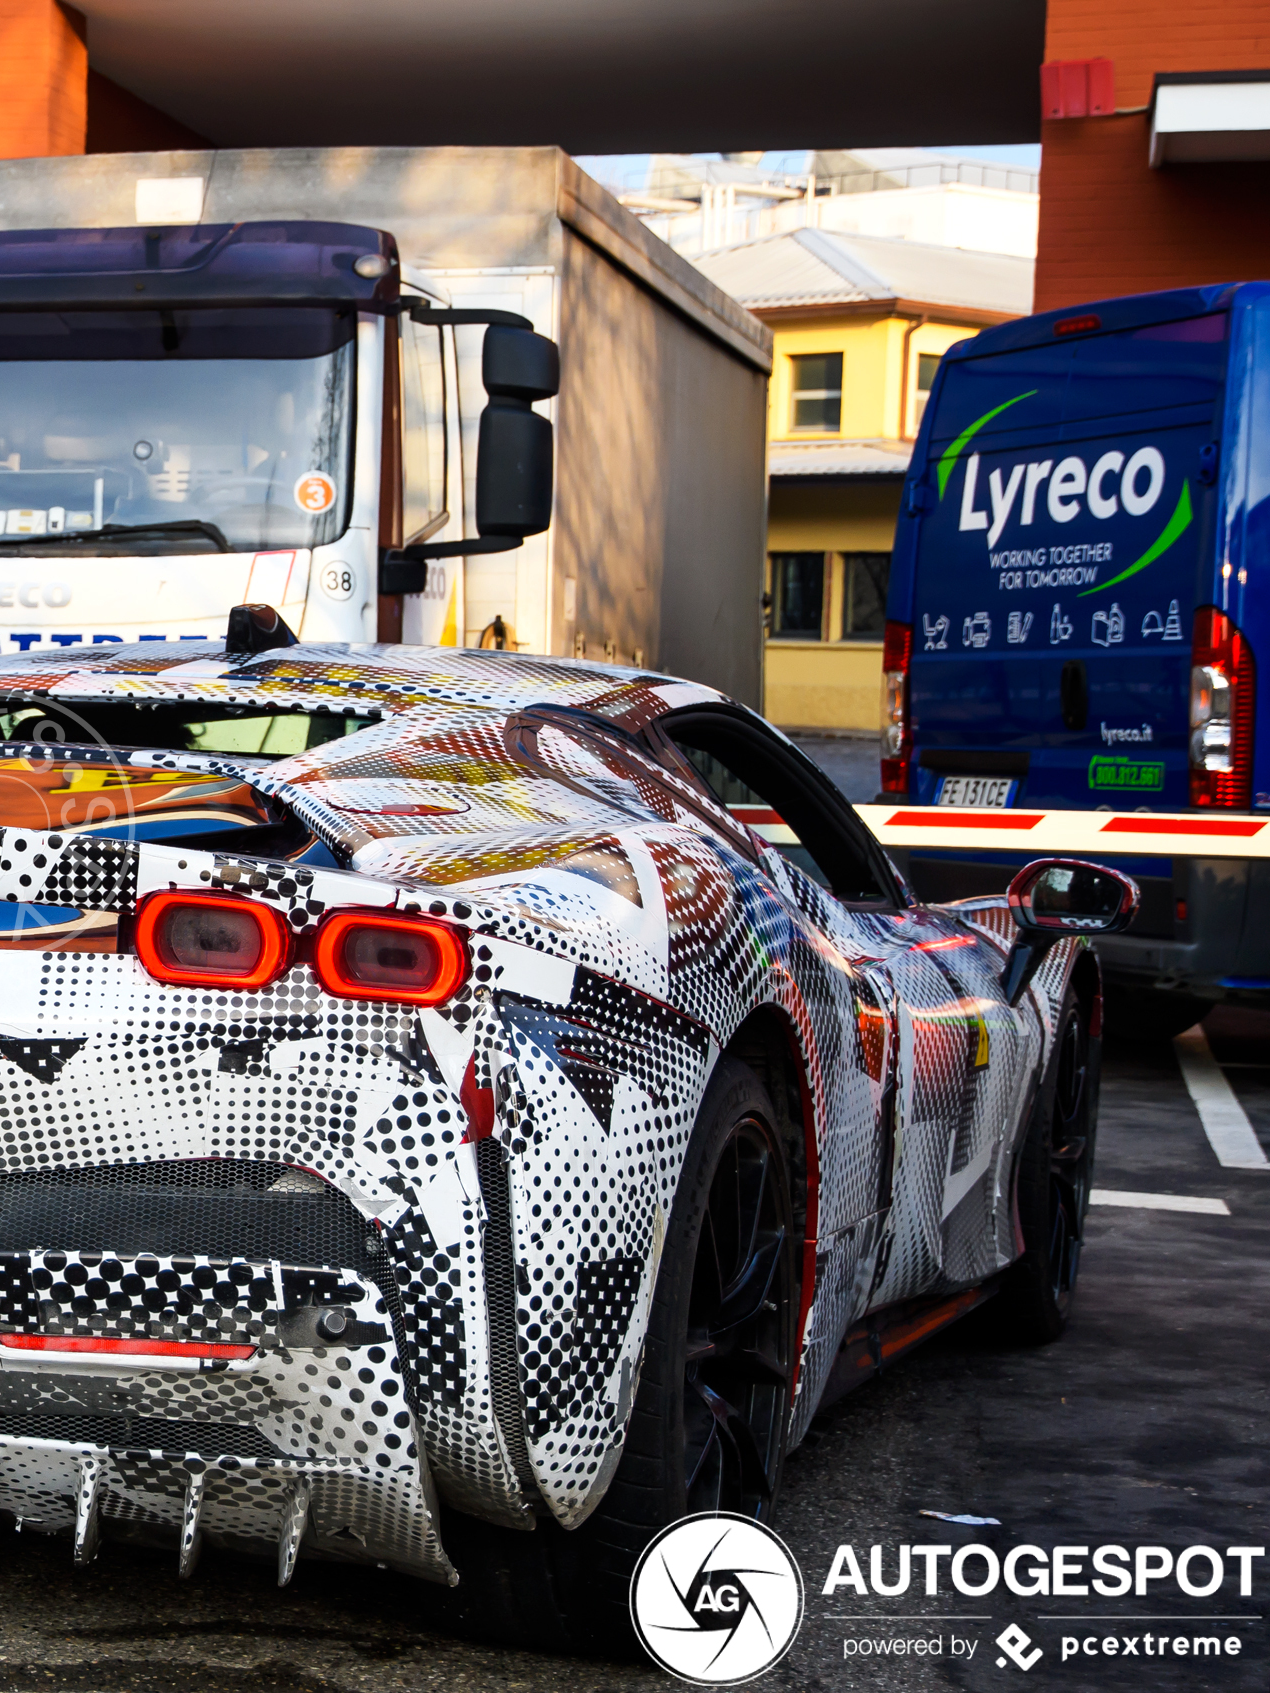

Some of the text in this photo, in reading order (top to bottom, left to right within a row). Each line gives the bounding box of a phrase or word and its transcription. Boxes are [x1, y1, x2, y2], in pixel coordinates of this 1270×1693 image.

[306, 486, 326, 509] 3
[959, 446, 1165, 550] Lyreco
[990, 542, 1113, 569] WORKING TOGETHER
[326, 570, 351, 592] 38
[999, 565, 1099, 590] FOR TOMORROW
[1101, 721, 1152, 746] lyreco.it
